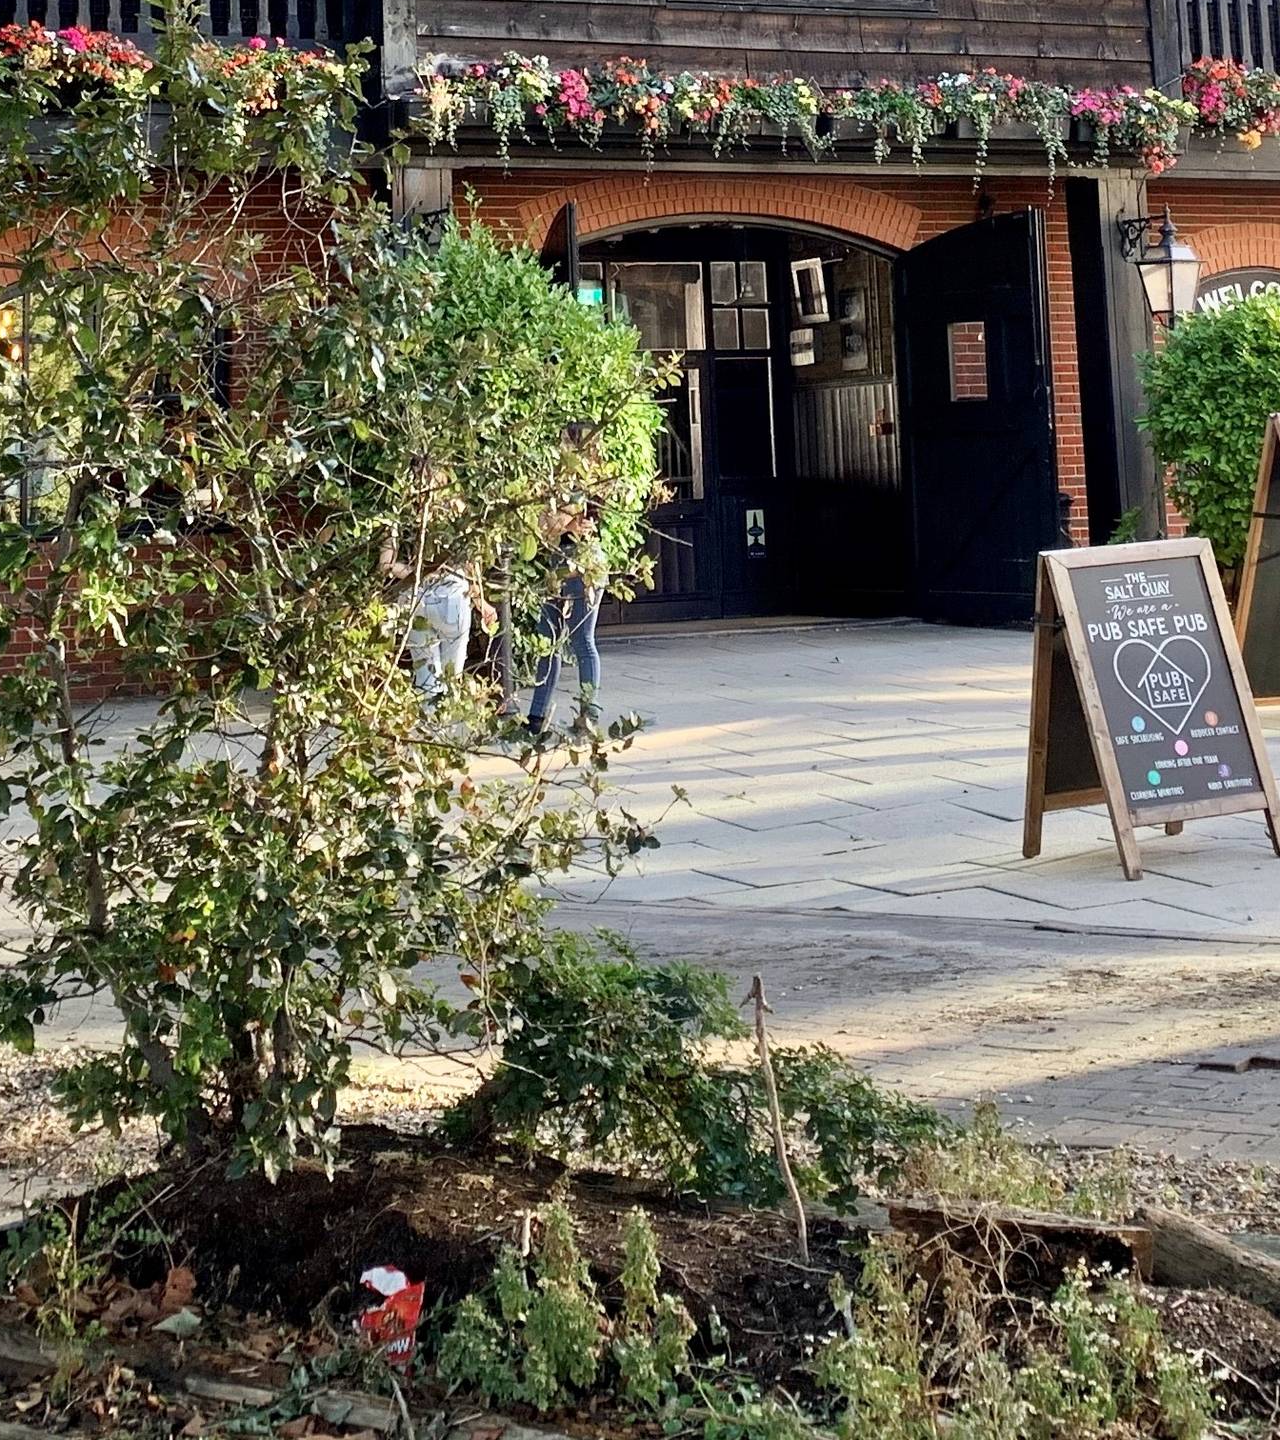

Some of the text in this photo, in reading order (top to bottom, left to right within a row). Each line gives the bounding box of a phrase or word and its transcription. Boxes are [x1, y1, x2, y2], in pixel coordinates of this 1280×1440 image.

[1124, 572, 1147, 584] THE
[1105, 580, 1171, 600] SALT QUAY
[1111, 603, 1173, 620] We are a
[1087, 613, 1208, 643] PUB SAFE PUB
[1148, 670, 1182, 689] PUB
[1153, 688, 1187, 702] SAFE
